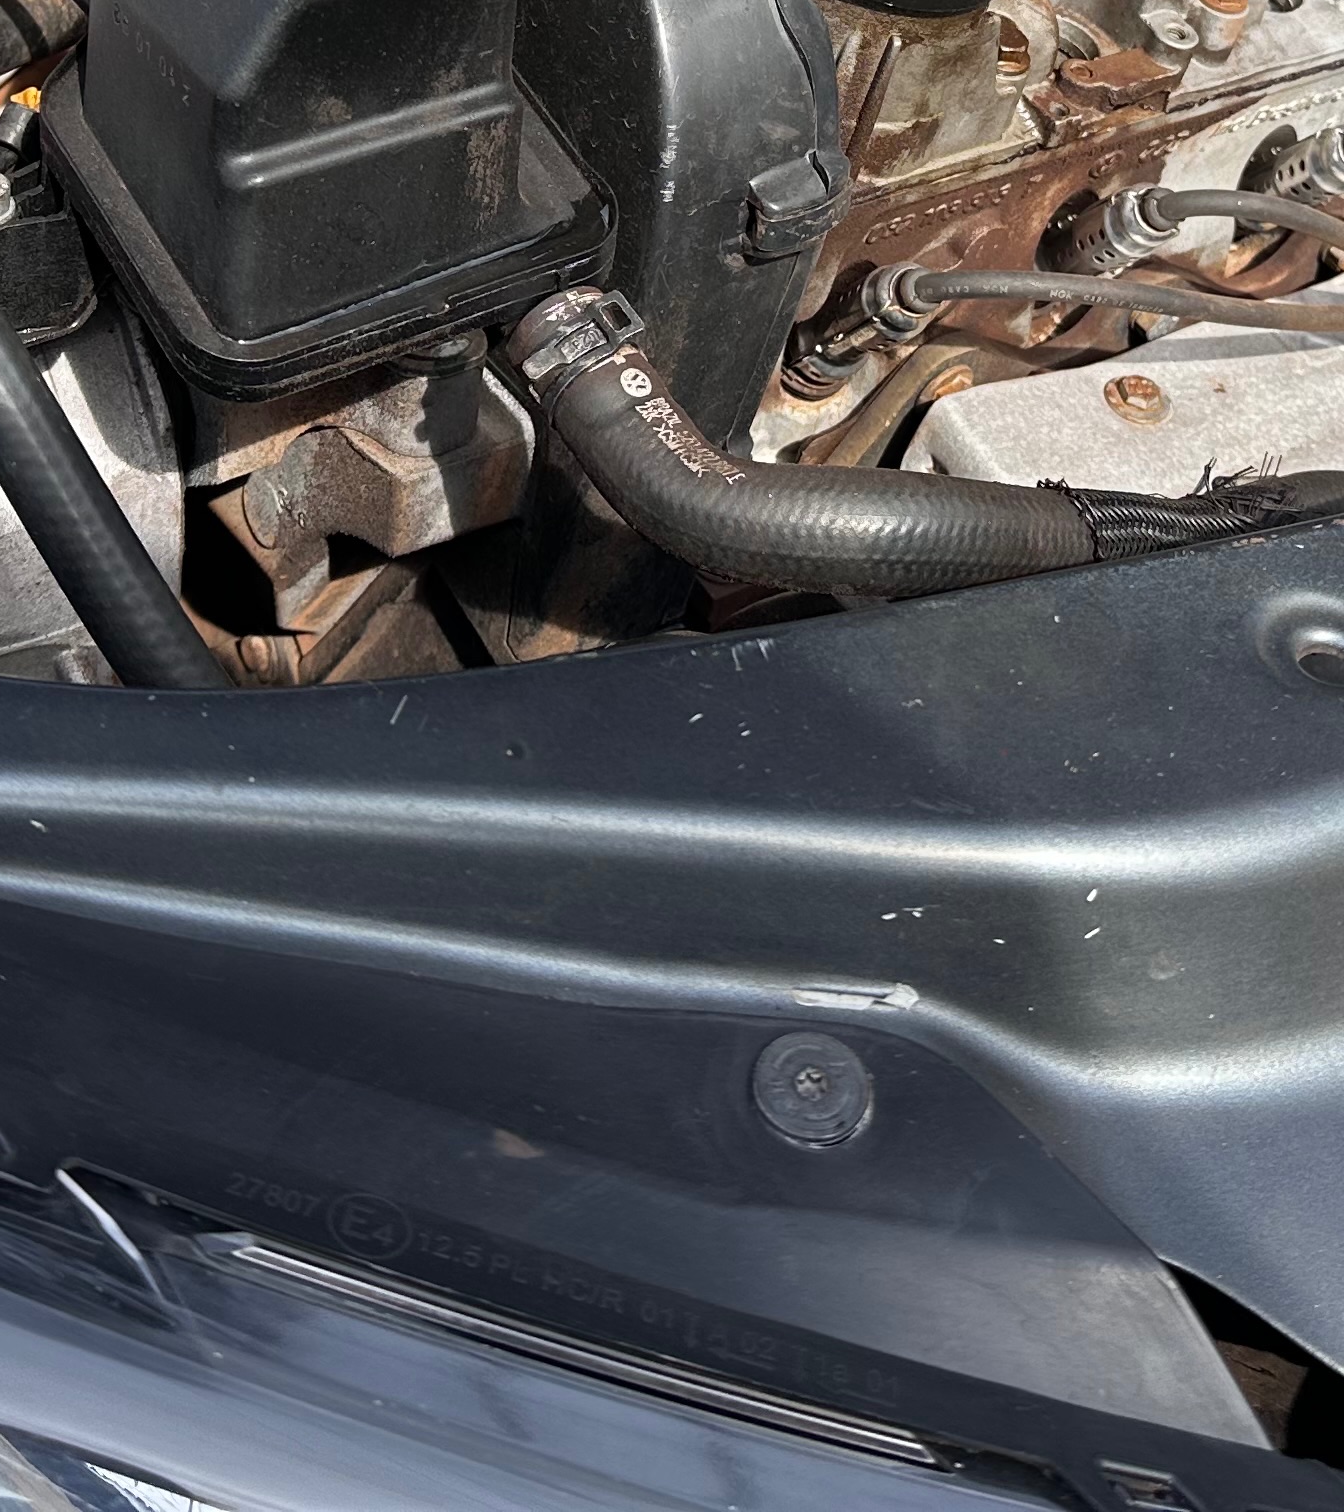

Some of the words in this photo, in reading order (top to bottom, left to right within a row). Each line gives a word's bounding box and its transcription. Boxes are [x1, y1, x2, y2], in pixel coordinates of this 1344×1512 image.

[225, 1171, 322, 1219] 27807
[417, 1229, 483, 1270] 12.5
[488, 1254, 534, 1285] PL
